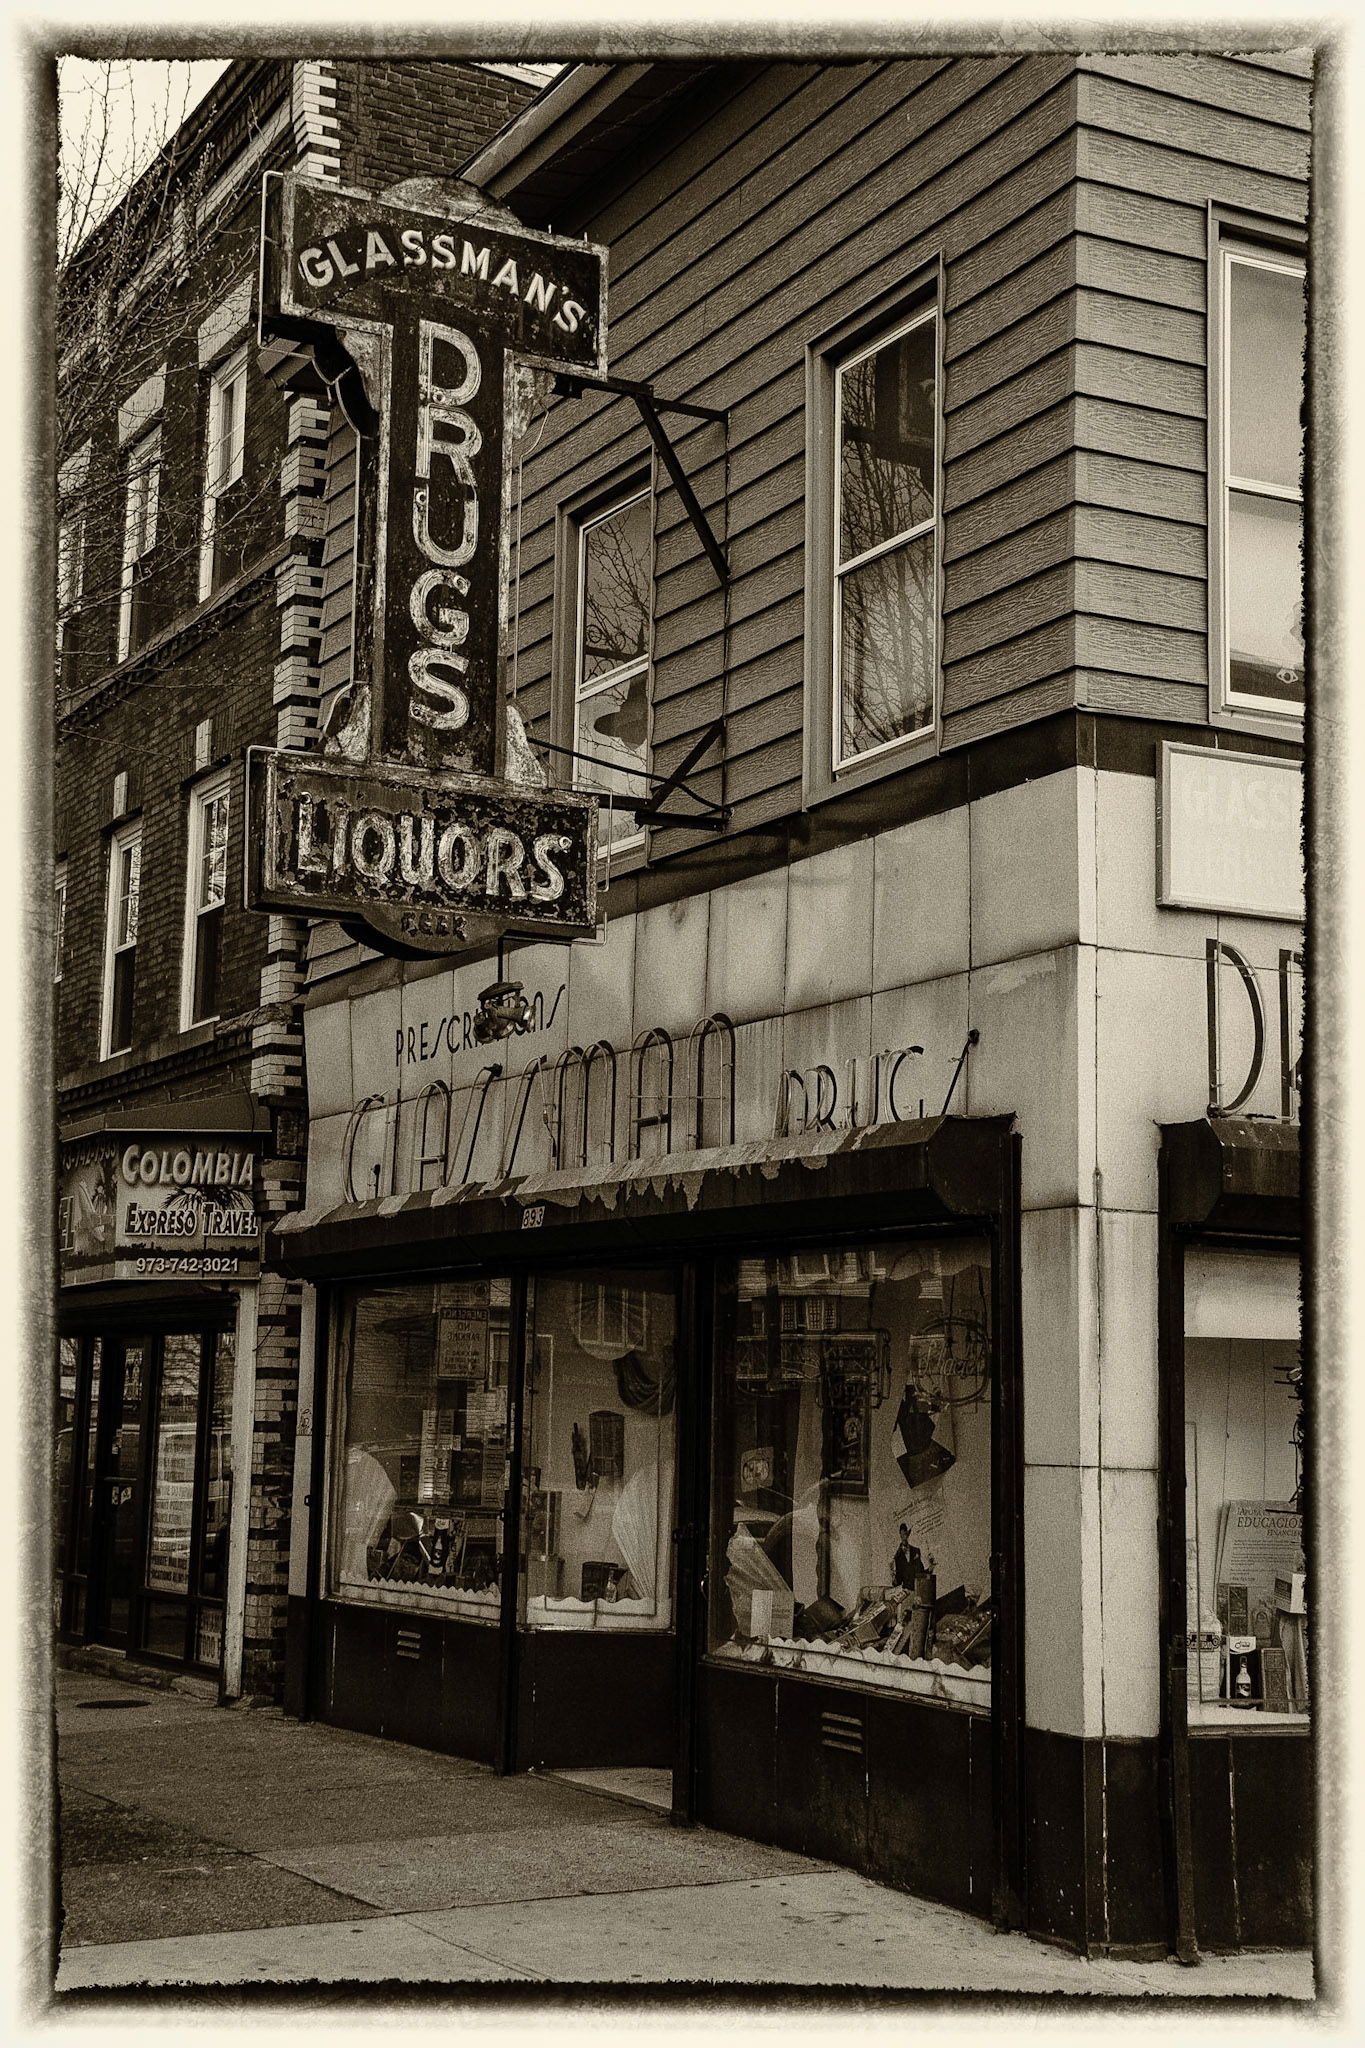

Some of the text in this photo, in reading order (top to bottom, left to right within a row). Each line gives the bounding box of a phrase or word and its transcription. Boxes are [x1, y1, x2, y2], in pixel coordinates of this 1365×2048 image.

[298, 228, 587, 335] GLASSMAN'S
[408, 318, 484, 731] DRUGS
[297, 792, 573, 901] LIQUORS
[122, 1143, 254, 1186] COLOMBIA
[124, 1201, 258, 1237] EXPRESO TRAVEL
[523, 1206, 544, 1228] 893
[136, 1257, 239, 1273] 973-742-3021
